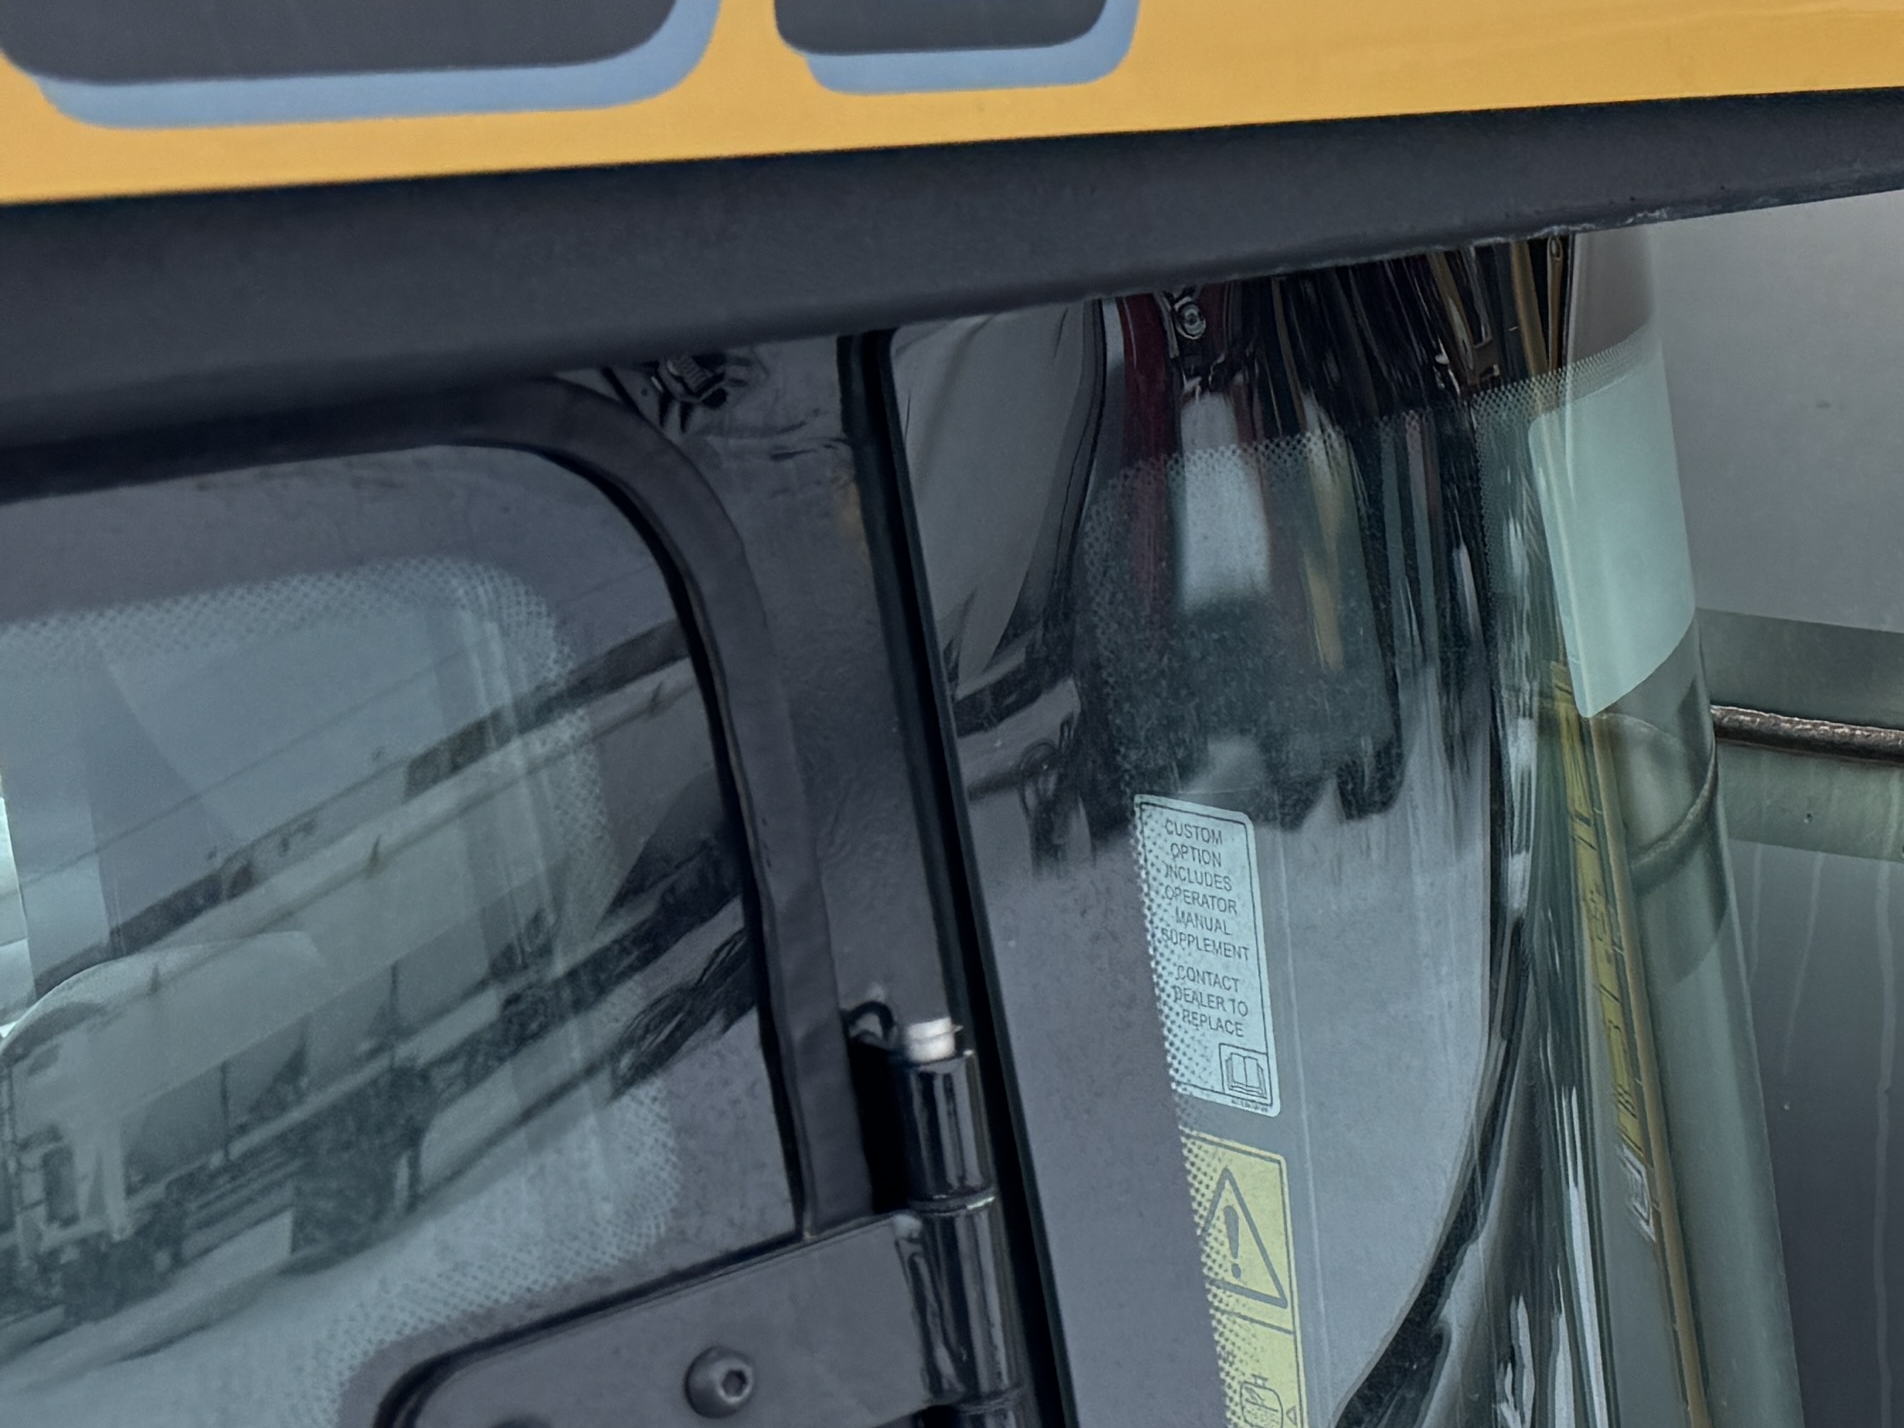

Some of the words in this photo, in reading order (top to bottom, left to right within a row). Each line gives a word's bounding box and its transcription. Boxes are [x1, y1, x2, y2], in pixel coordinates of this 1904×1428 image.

[1165, 819, 1222, 844] CUSTOM
[1171, 842, 1221, 867] OPTION
[1164, 862, 1232, 891] INCLUDES
[1165, 885, 1237, 915] OPERATOR
[1176, 906, 1233, 935] MANUAL
[1161, 928, 1249, 960] SUPPLEMENT
[1177, 965, 1239, 992] CONTACT
[1173, 985, 1226, 1012] DEALER
[1229, 999, 1248, 1016] TO
[1182, 1009, 1244, 1037] REPLACE
